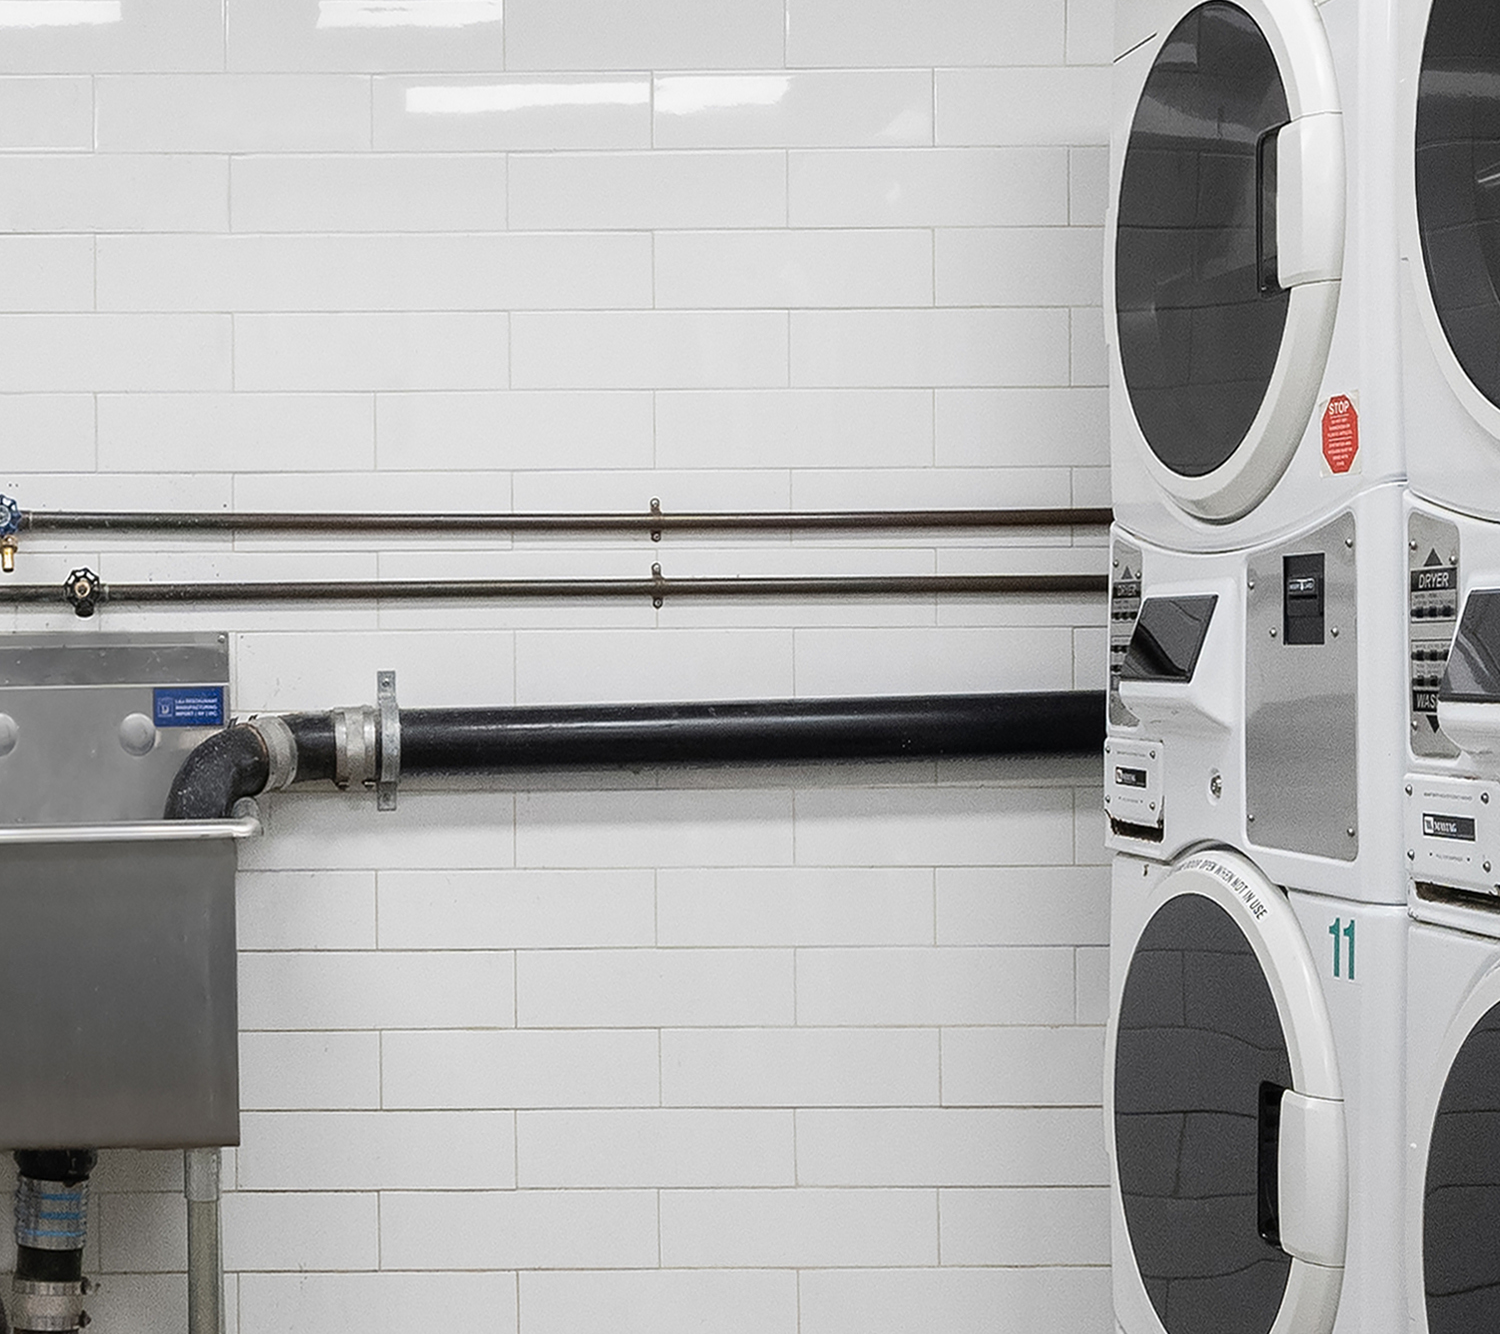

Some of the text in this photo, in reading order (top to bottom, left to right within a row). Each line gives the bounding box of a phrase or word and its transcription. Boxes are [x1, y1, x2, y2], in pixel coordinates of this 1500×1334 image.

[1328, 400, 1350, 415] STOP
[1418, 572, 1449, 589] DRYER
[1416, 693, 1437, 709] WAS
[1230, 877, 1249, 895] NOT
[1242, 889, 1256, 904] IN
[1249, 898, 1268, 920] USE
[1329, 917, 1355, 980] 11
